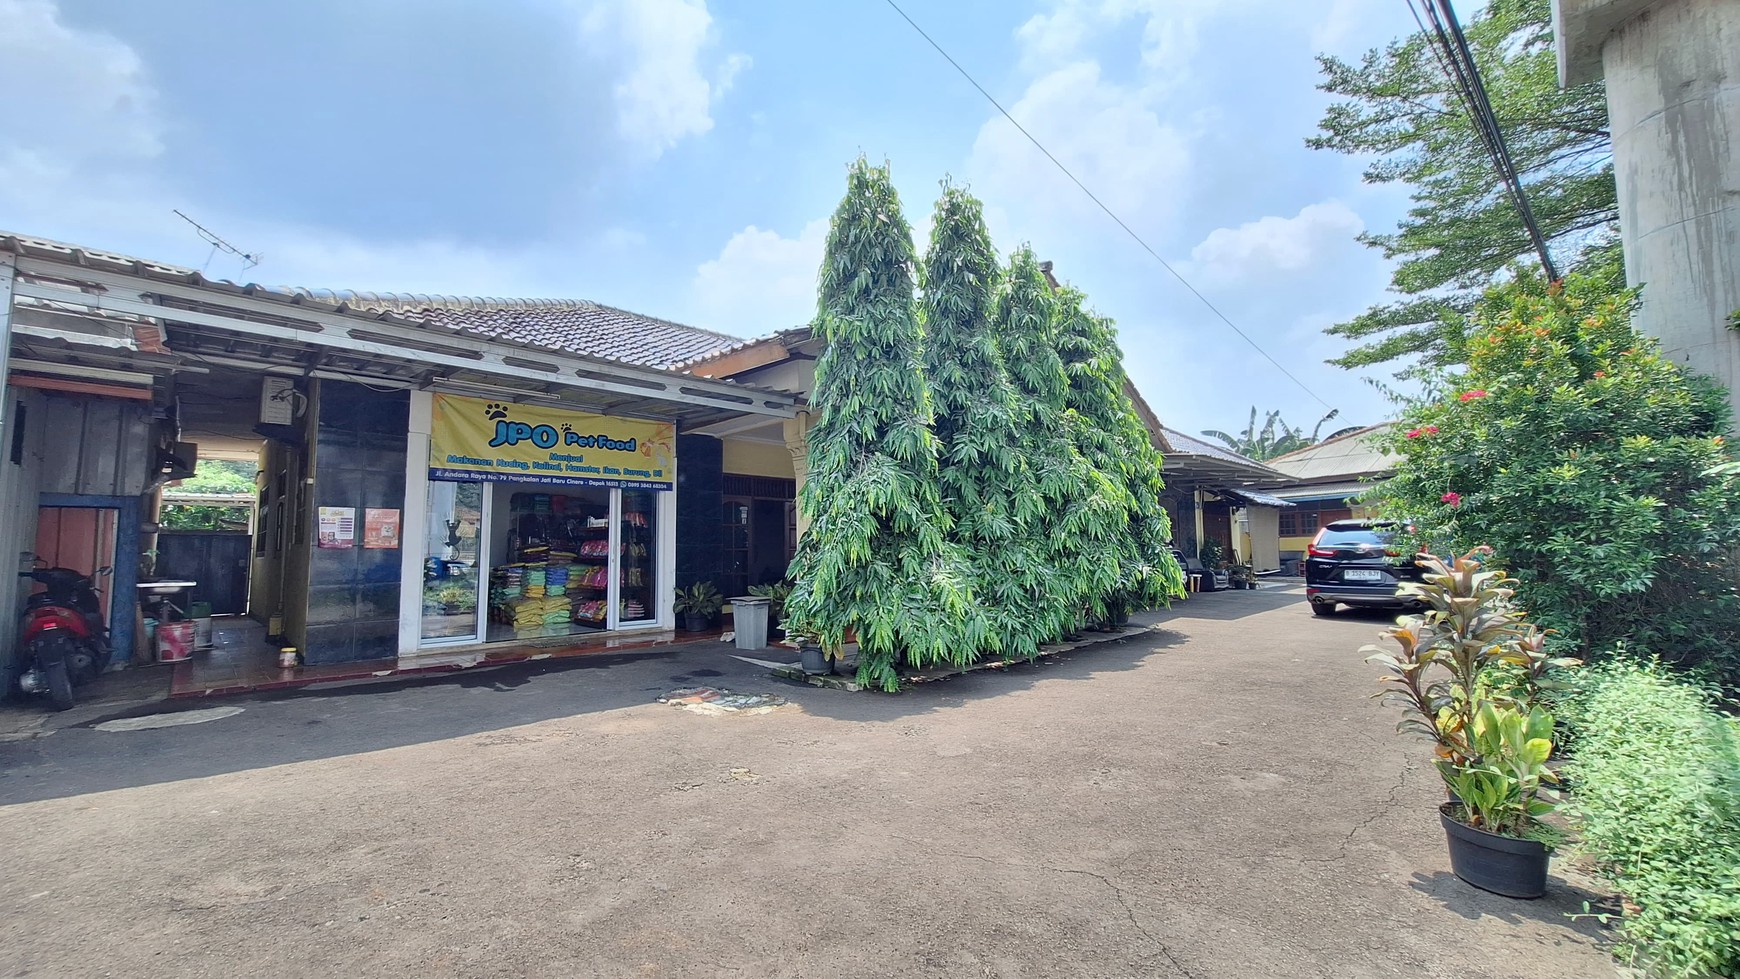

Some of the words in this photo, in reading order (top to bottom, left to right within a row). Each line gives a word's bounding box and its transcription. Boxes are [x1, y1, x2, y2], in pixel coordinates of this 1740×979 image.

[488, 420, 558, 449] JPO
[564, 432, 597, 447] Pet
[596, 435, 636, 452] Food
[447, 454, 493, 466] Makanan
[496, 458, 530, 470] Kucing,
[566, 463, 601, 474] Hamster,
[549, 453, 583, 463] Menjual
